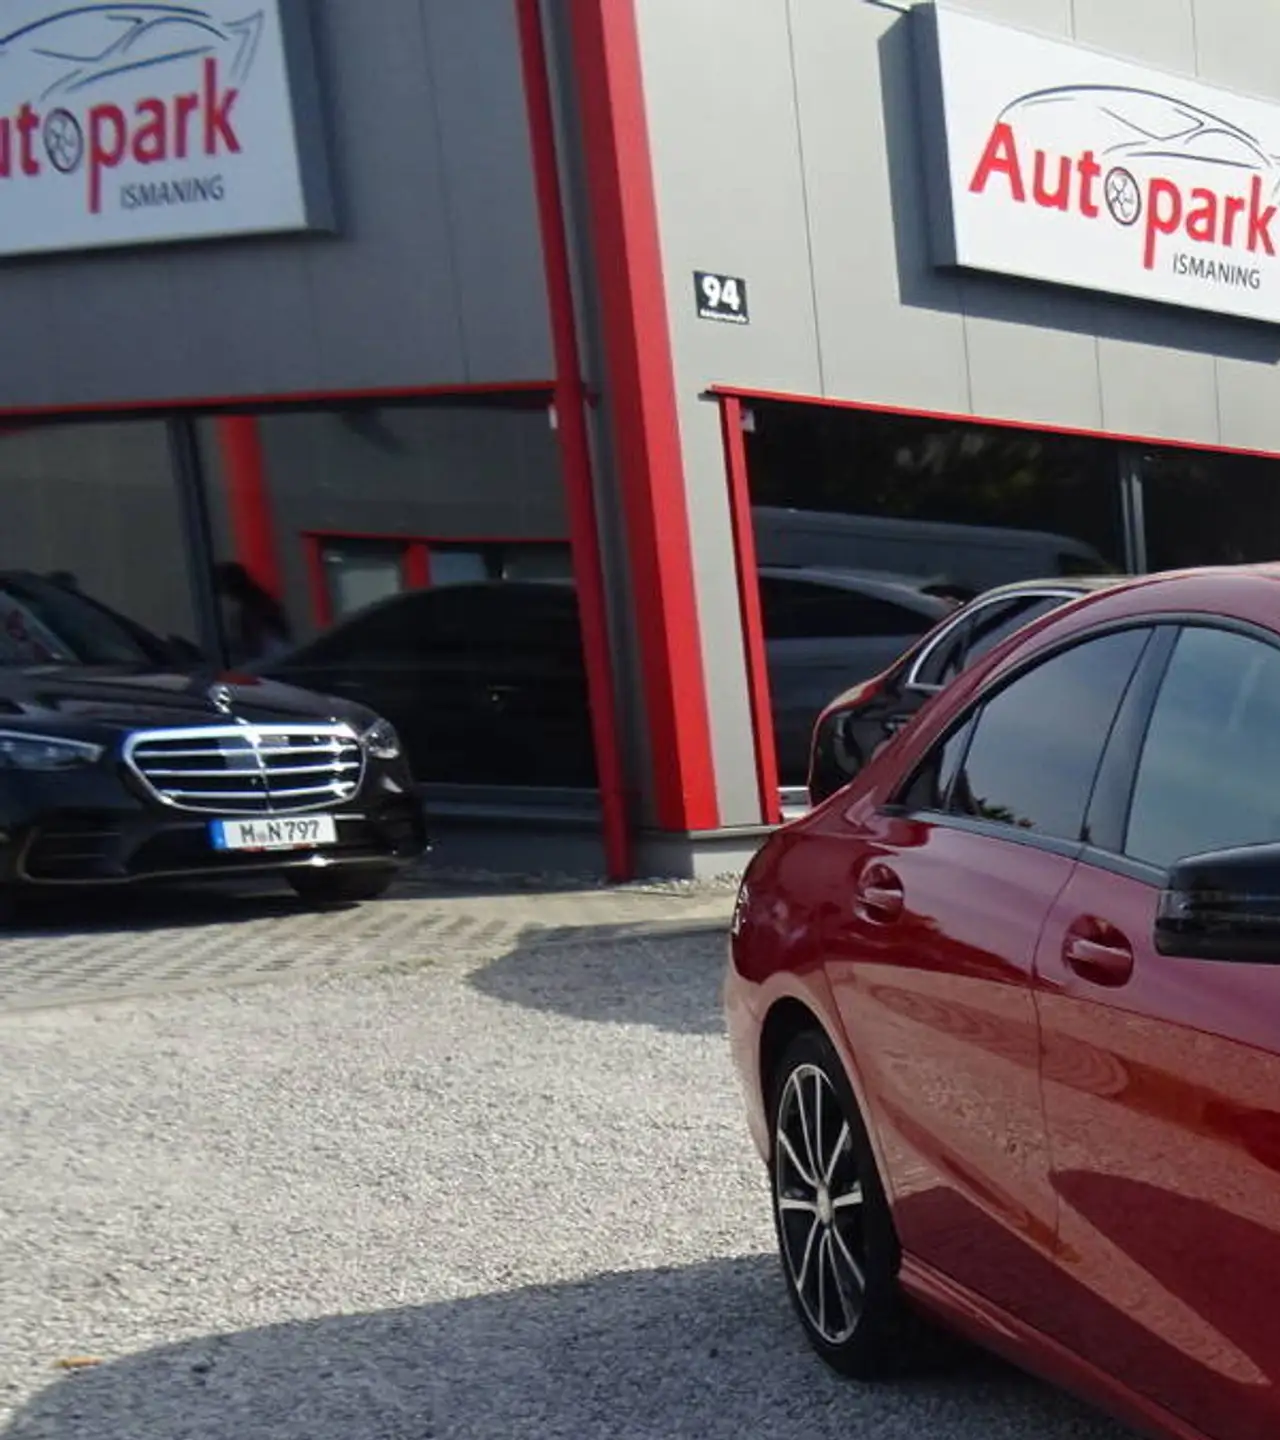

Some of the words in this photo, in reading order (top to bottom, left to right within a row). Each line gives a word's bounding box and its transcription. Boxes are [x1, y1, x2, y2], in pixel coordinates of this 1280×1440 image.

[120, 174, 225, 210] ISMANING
[968, 120, 1277, 270] Autopark
[1172, 253, 1261, 290] ISMANING
[702, 275, 741, 310] 94
